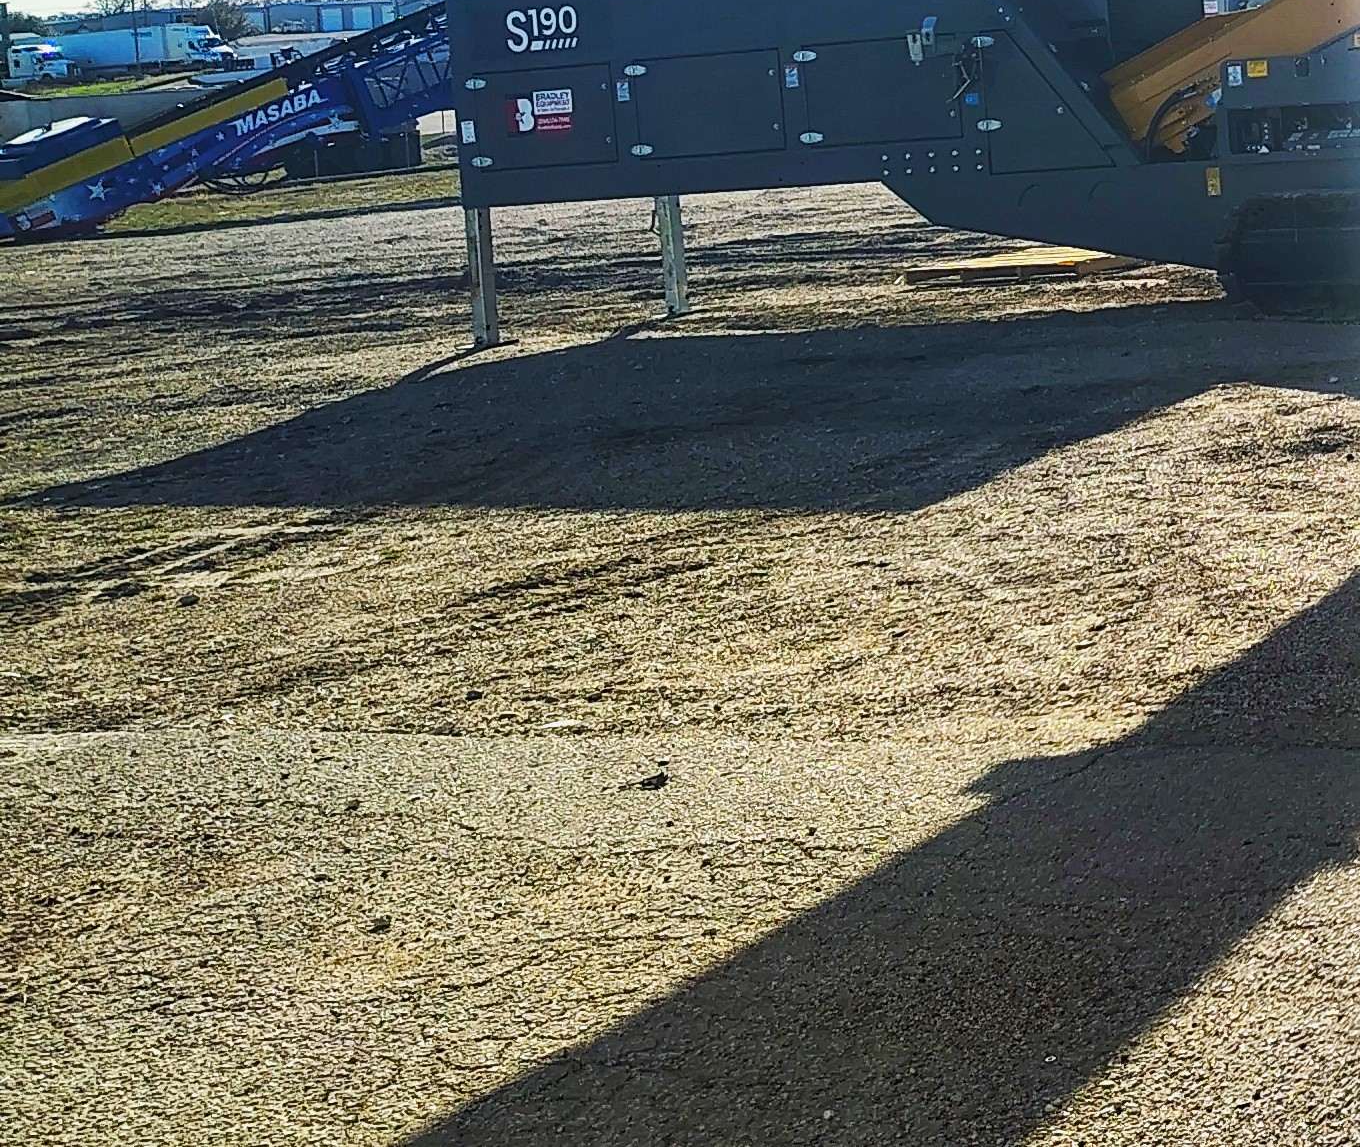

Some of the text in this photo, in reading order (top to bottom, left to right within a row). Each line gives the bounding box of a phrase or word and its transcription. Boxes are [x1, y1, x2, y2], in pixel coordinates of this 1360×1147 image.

[506, 5, 577, 53] S190
[229, 89, 328, 136] MASABA
[535, 91, 569, 101] BRADLEY
